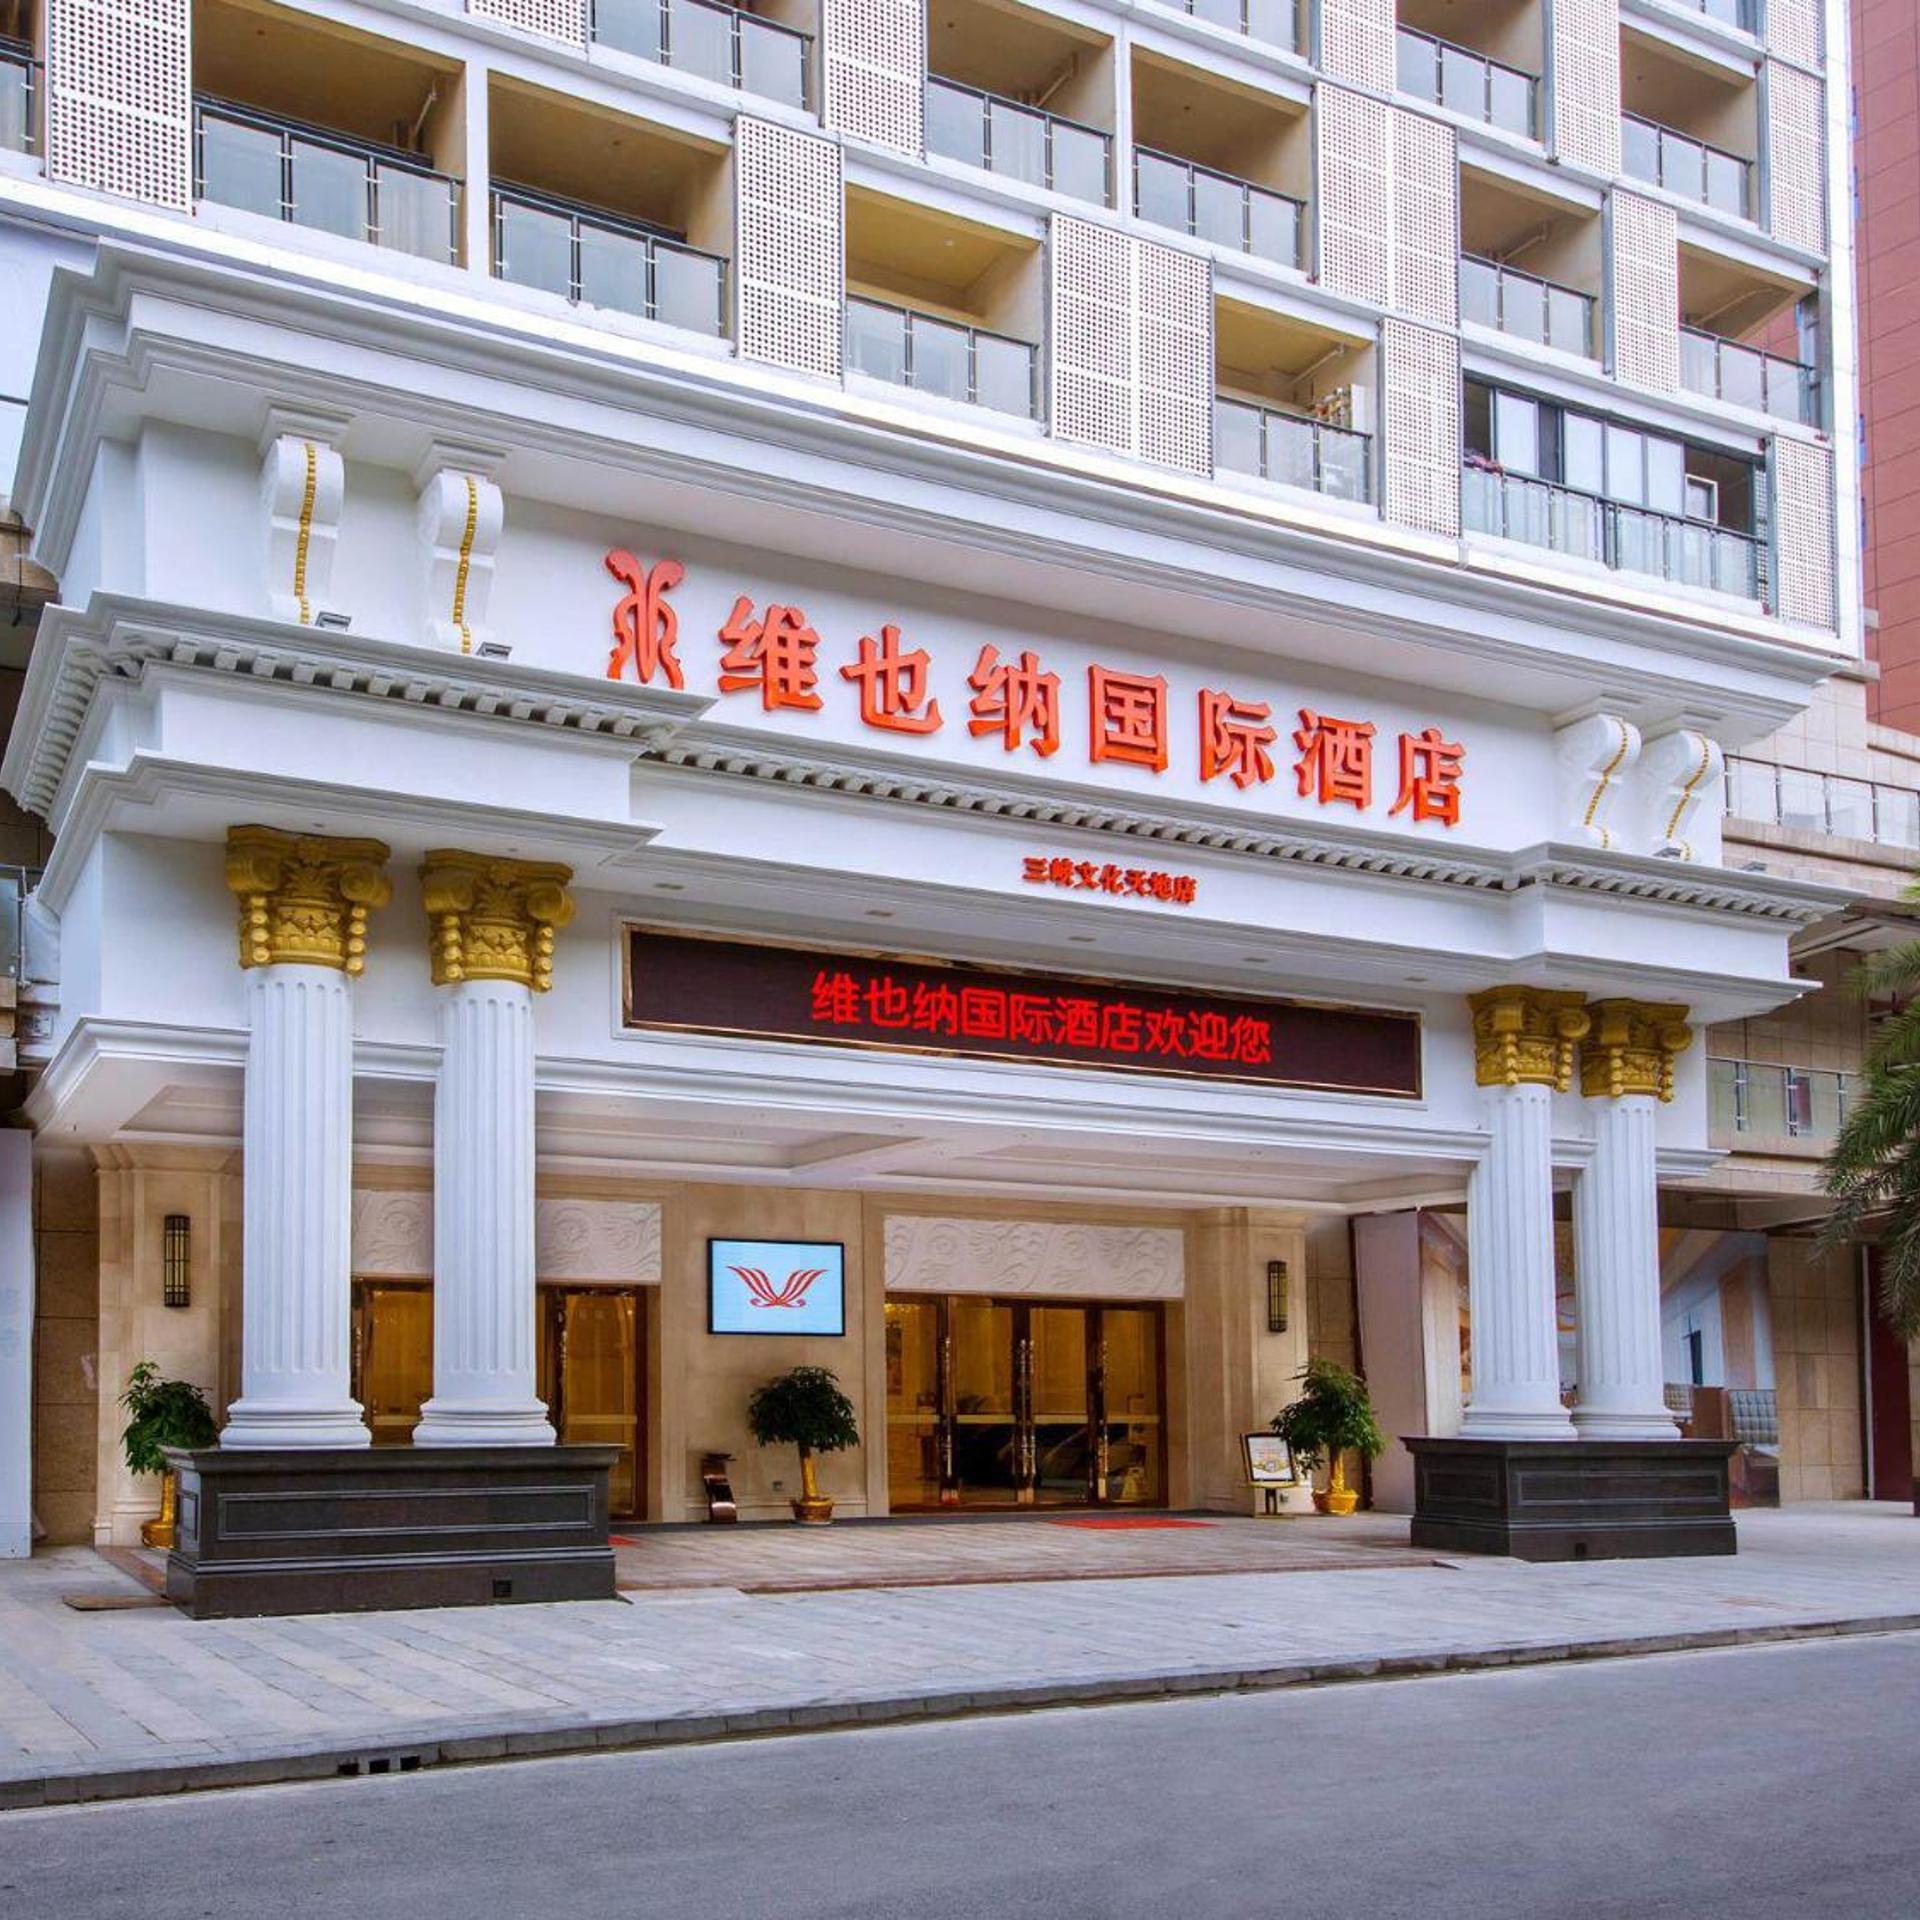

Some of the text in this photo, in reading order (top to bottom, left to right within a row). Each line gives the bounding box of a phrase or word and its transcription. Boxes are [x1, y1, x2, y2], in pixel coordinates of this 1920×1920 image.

[719, 595, 1463, 827] 维也纳国际酒店
[811, 970, 1273, 1065] 维也纳国际酒店欢迎您
